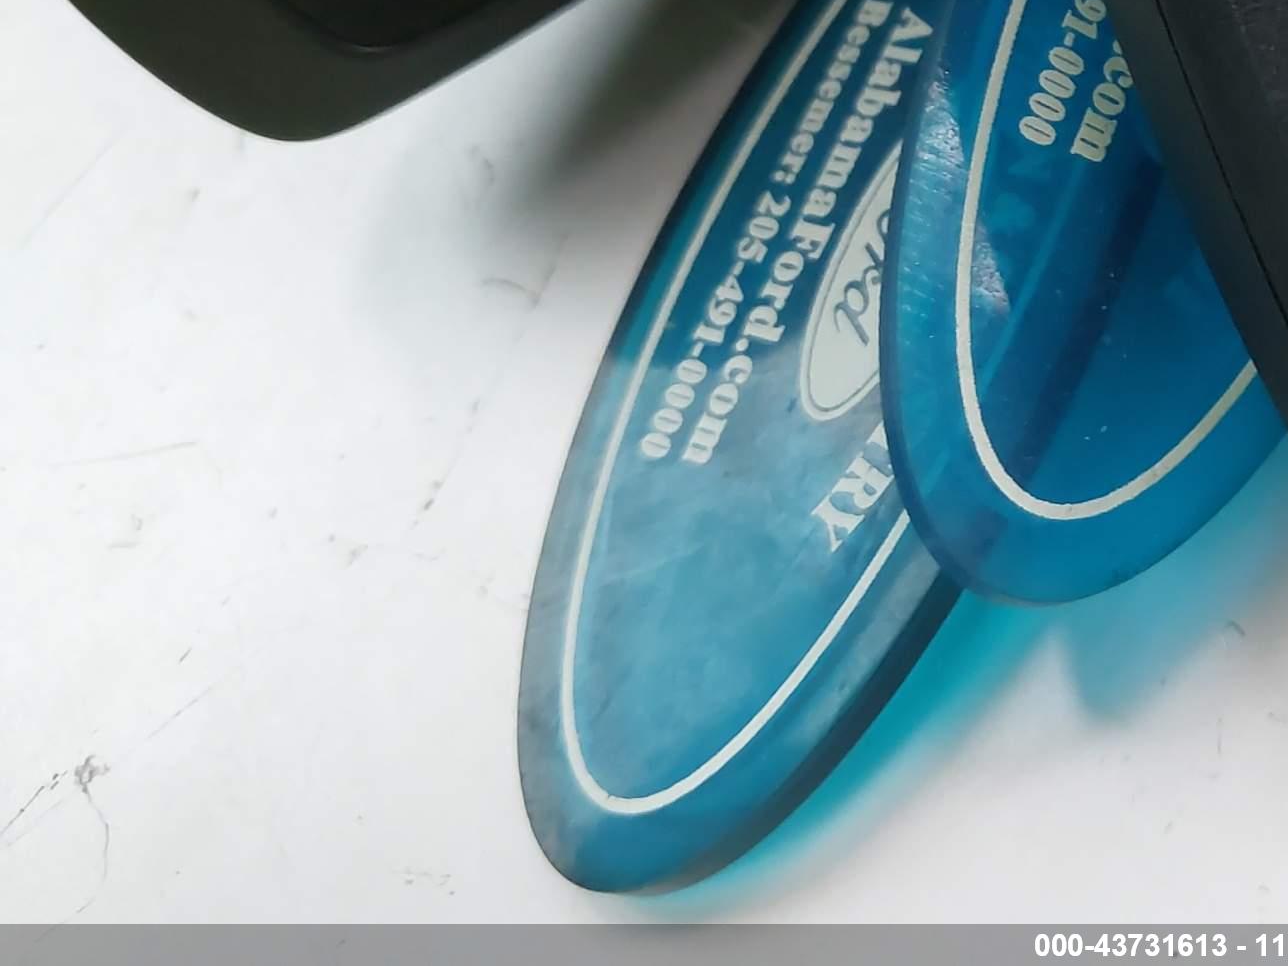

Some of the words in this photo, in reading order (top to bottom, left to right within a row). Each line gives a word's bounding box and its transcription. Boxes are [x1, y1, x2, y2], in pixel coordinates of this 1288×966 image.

[640, 190, 791, 459] 205-491-0000
[682, 7, 933, 464] AlabamaFord.com
[833, 208, 892, 347] rd
